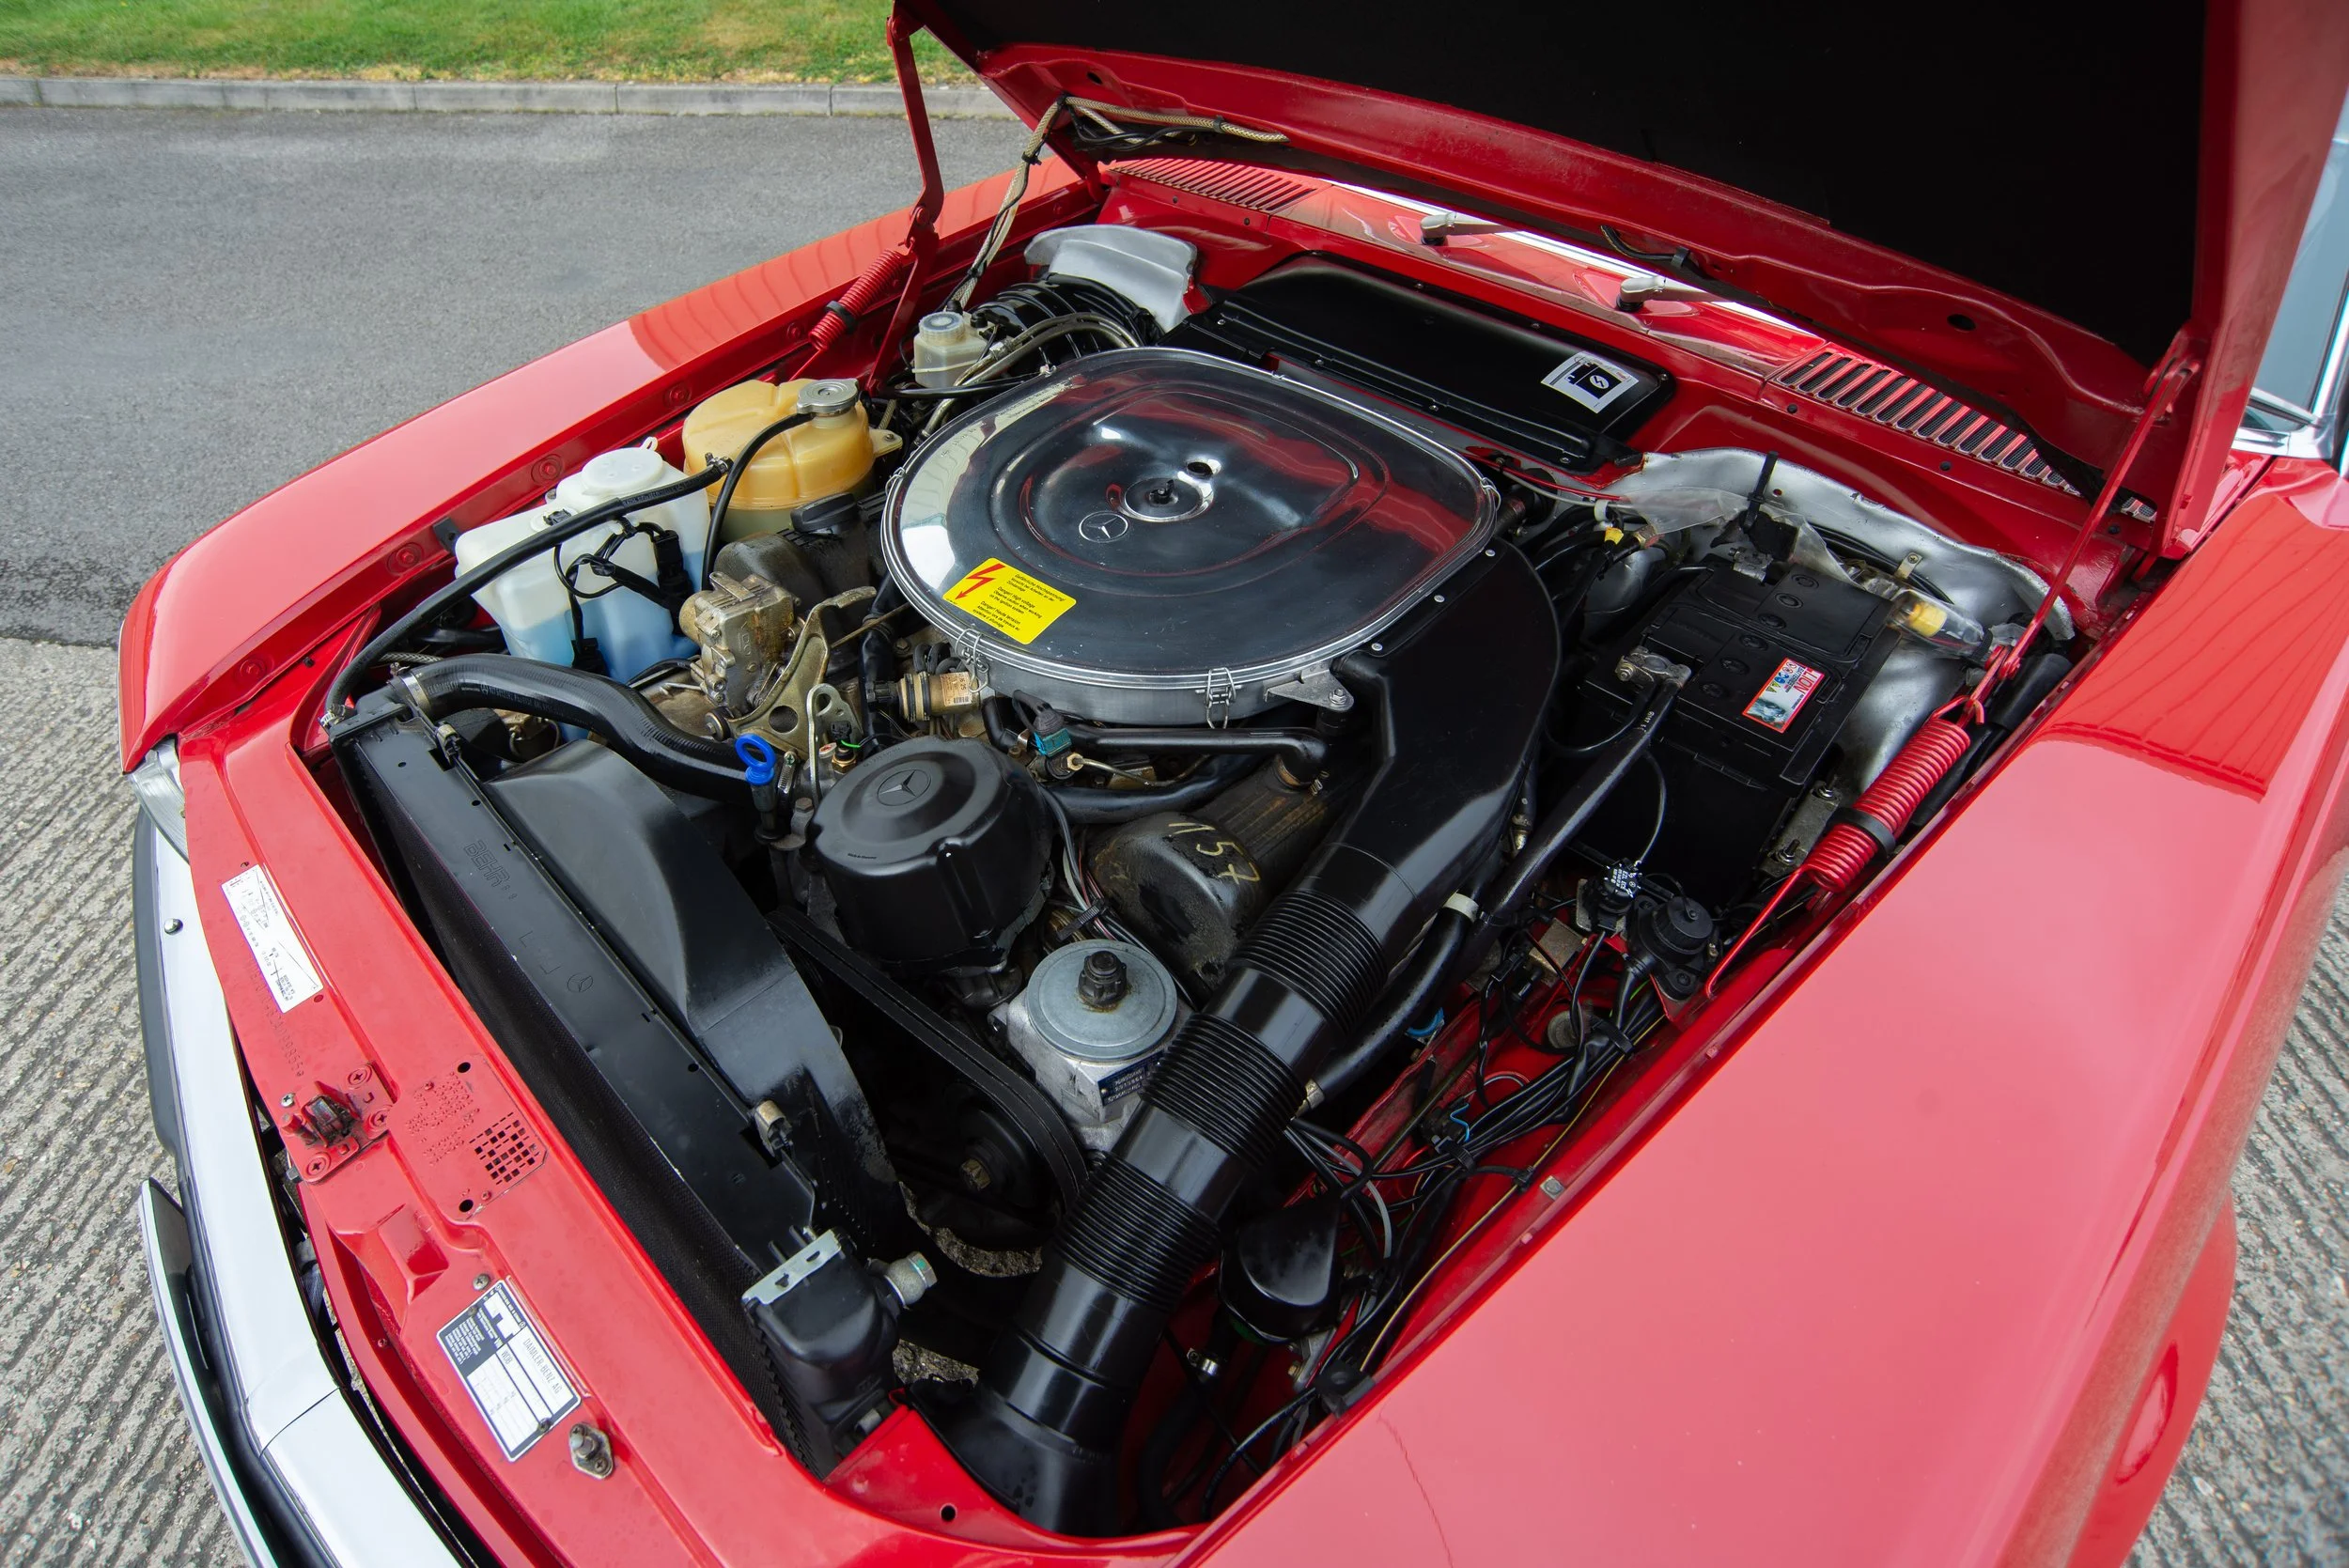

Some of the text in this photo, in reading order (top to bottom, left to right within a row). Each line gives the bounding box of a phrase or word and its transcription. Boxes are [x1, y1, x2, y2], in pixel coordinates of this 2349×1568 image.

[1020, 599, 1035, 609] voltage
[1794, 670, 1818, 694] LION
[463, 839, 510, 888] BEHR
[522, 1337, 563, 1394] DAIMLER-BENZ AG
